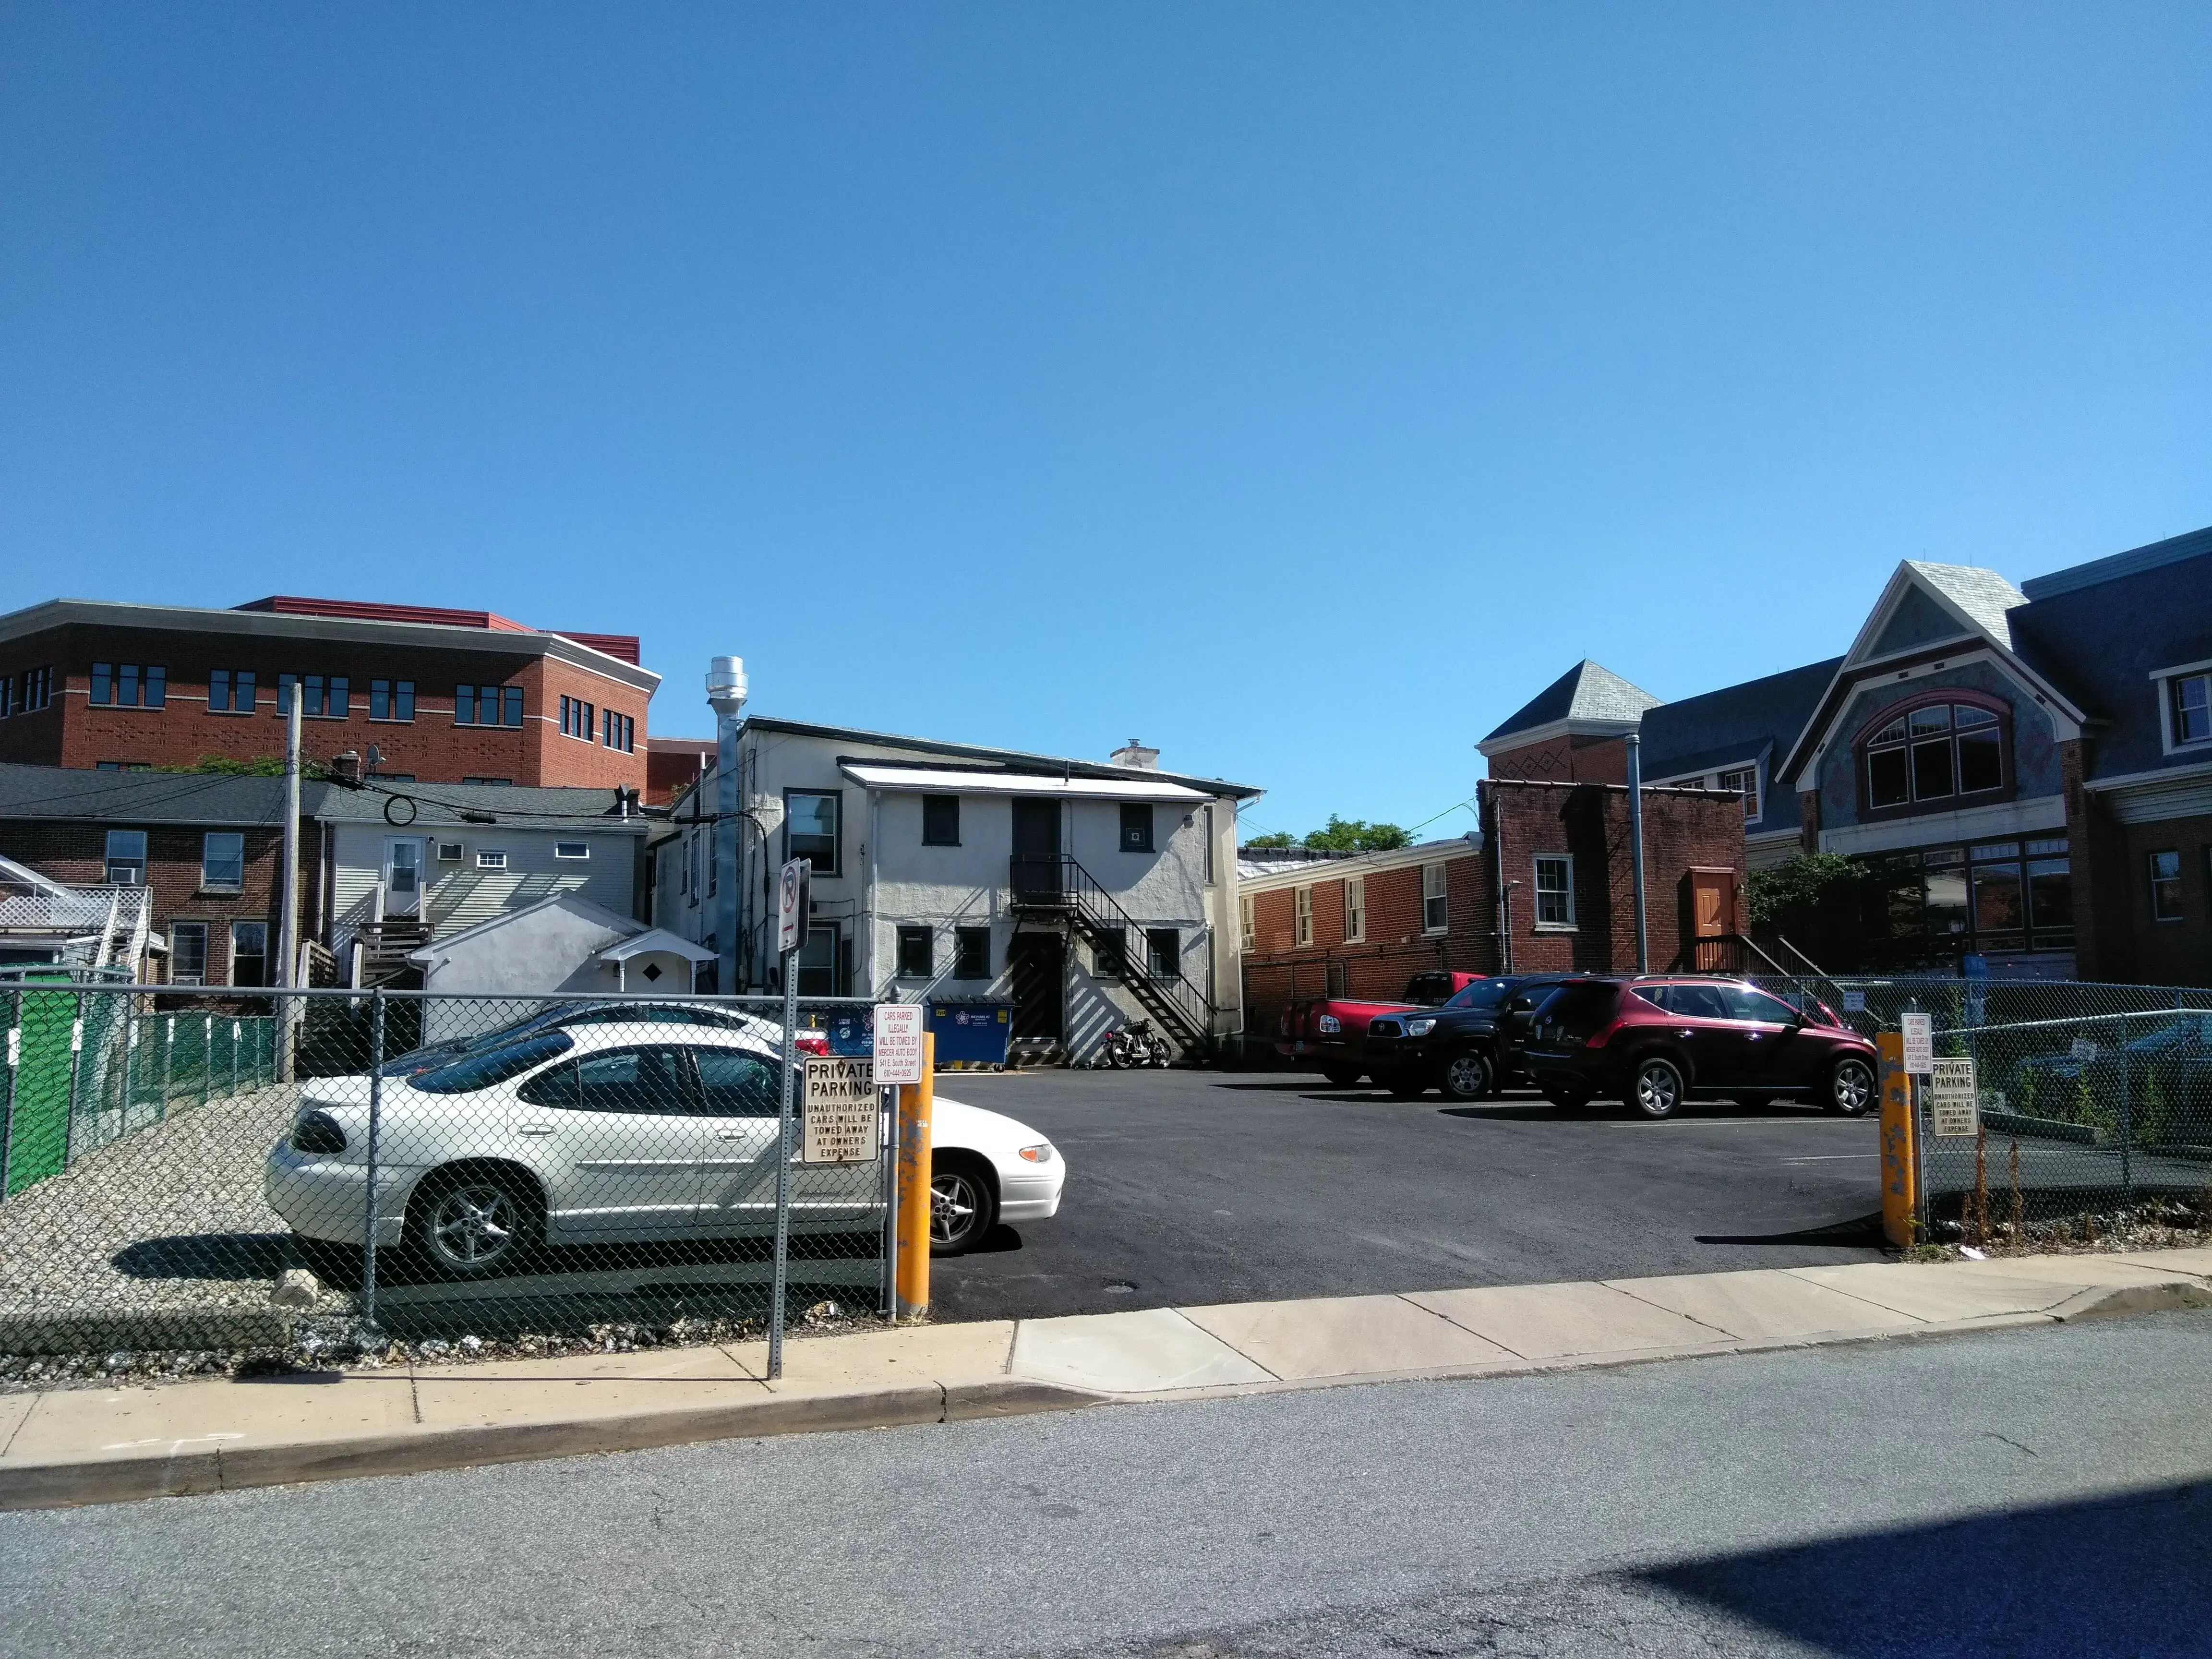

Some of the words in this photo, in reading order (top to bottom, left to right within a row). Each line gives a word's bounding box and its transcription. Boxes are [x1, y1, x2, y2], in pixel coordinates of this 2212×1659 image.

[884, 1011, 896, 1021] CARS
[897, 1011, 913, 1021] PARKED
[888, 1024, 909, 1033] ILLEGALLY
[879, 1037, 888, 1046] WILL
[890, 1036, 895, 1046] BE
[897, 1036, 911, 1046] TOWED
[912, 1036, 917, 1046] BY
[878, 1048, 894, 1057] MERCER
[904, 1058, 916, 1067] Street
[808, 1063, 873, 1079] PRIVATE
[884, 1069, 911, 1077] 610-444-0925
[1933, 1063, 1972, 1075] PRIVATE
[1935, 1076, 1972, 1088] PARKING
[811, 1081, 872, 1097] PARKING
[1934, 1092, 1974, 1100] UNAUTHORIZED
[807, 1103, 875, 1113] UNAUTHORIZED
[810, 1115, 834, 1124] CARS
[838, 1114, 858, 1123] WILL
[861, 1114, 872, 1122] BE
[814, 1126, 842, 1135] TOWED
[846, 1125, 869, 1134] AWAY
[816, 1137, 827, 1146] AT
[830, 1136, 866, 1146] OWNERS
[820, 1147, 861, 1157] EXPENSE
